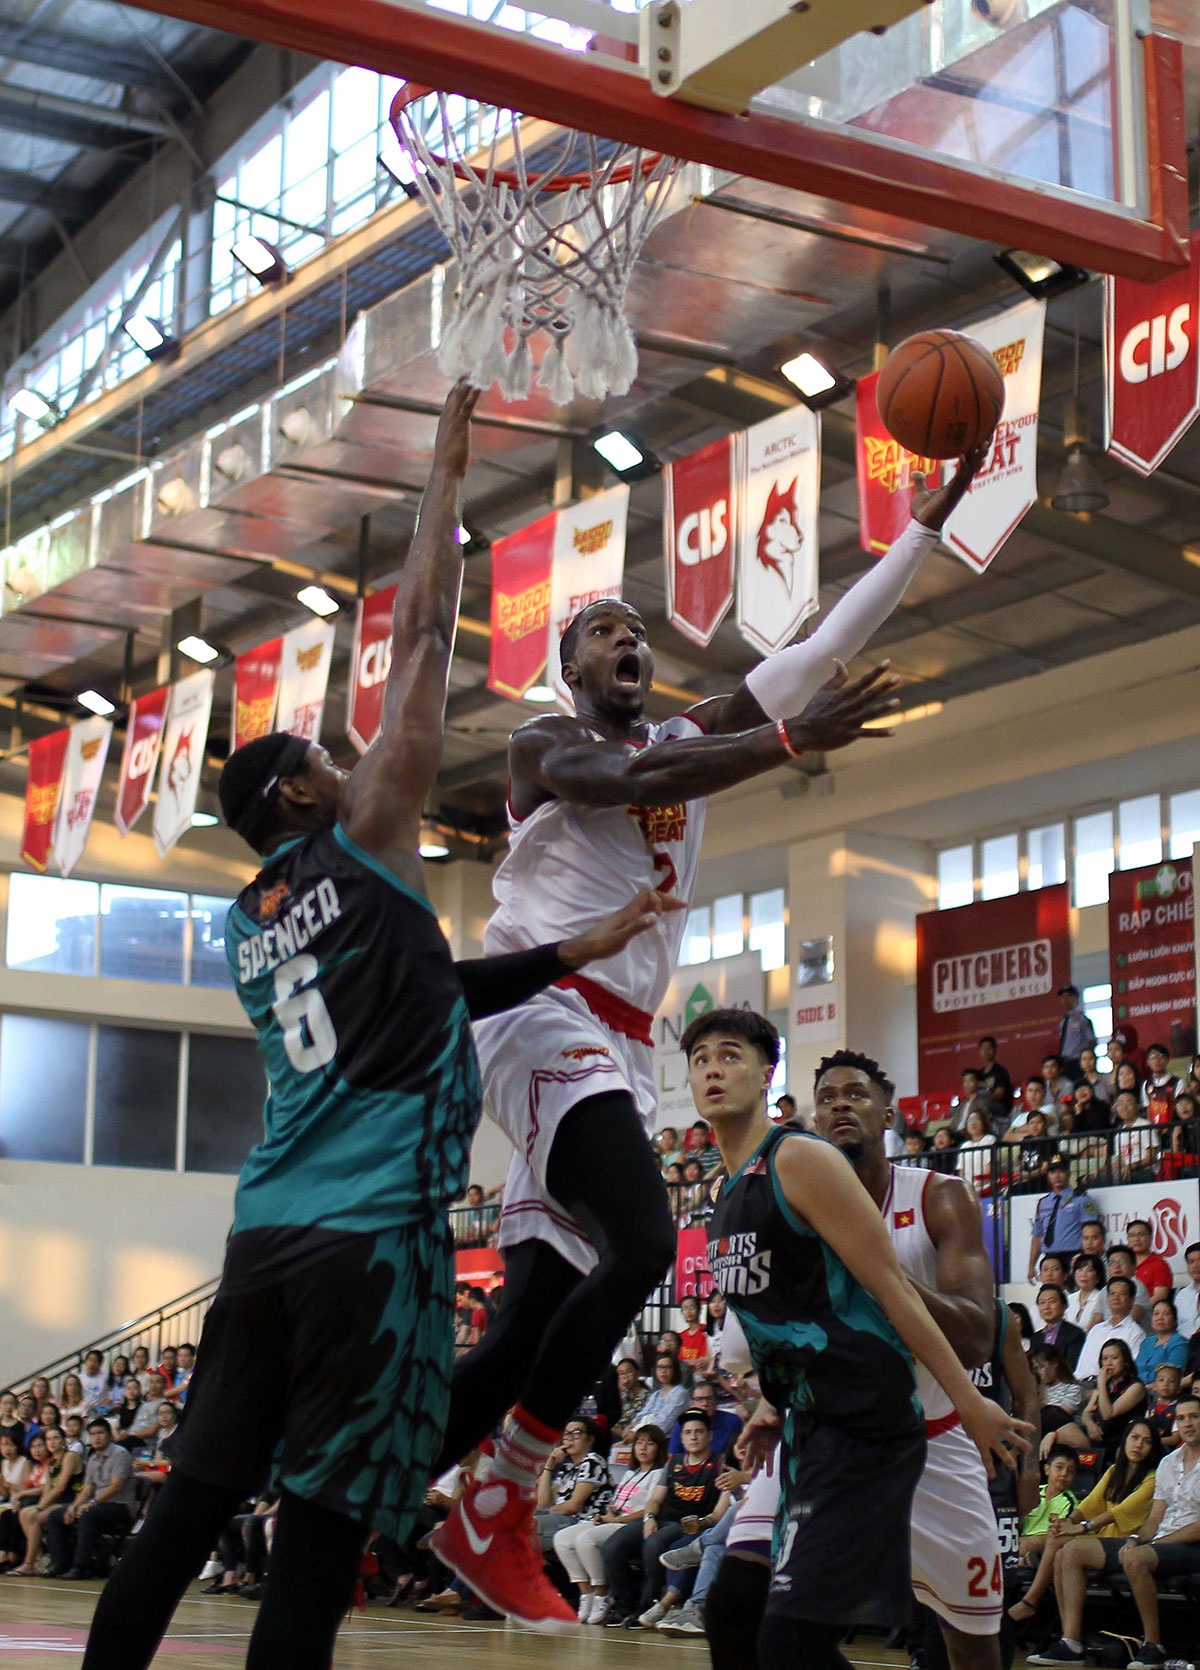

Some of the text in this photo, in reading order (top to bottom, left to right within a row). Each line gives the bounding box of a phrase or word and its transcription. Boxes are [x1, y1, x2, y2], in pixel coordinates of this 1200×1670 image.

[1120, 303, 1191, 384] CIS
[764, 433, 798, 458] ARCTIC
[677, 499, 728, 566] CIS
[360, 635, 393, 689] CIS
[653, 852, 678, 893] 2
[238, 877, 342, 984] SPENCER
[937, 943, 1049, 995] PITCHERS
[272, 953, 338, 1073] 6
[797, 1003, 836, 1025] SIDE B
[999, 1517, 1019, 1553] 55
[967, 1554, 1001, 1598] 24
